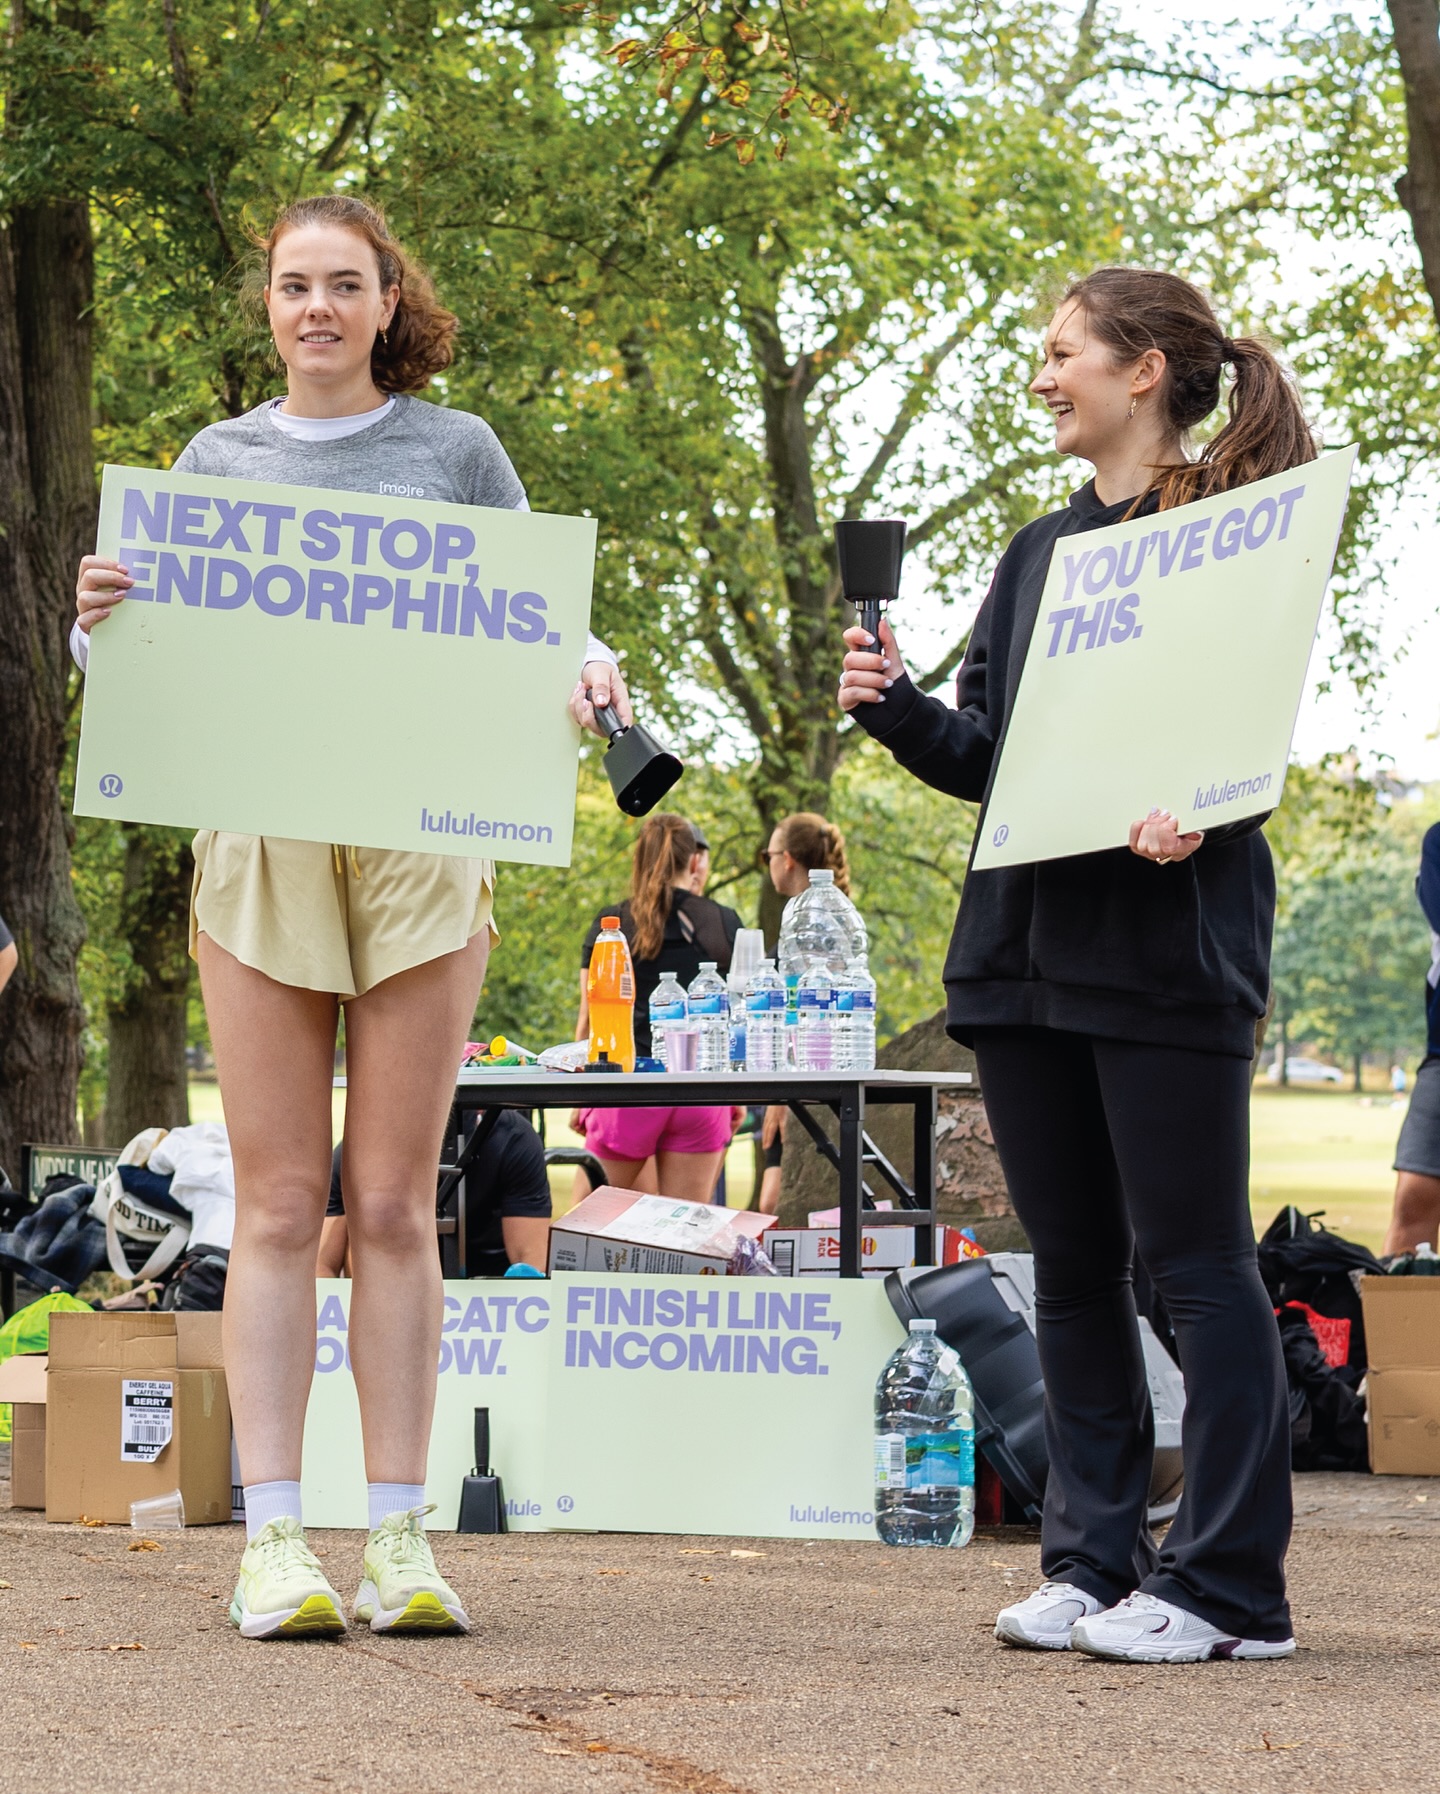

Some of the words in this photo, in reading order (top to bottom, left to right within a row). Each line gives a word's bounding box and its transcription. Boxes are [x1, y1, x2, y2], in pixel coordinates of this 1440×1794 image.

[379, 481, 425, 497] [mo]re
[121, 488, 296, 556] NEXT
[299, 508, 480, 588] STOP,
[1061, 517, 1212, 601] YOU'VE
[1211, 484, 1306, 561] GOT
[118, 548, 561, 646] ENDORPHINS.
[1046, 593, 1144, 658] THIS.
[1193, 772, 1272, 811] lululemon
[420, 808, 553, 844] lululemon
[135, 1211, 175, 1234] TIM
[817, 1237, 826, 1258] PACK
[442, 1296, 550, 1333] CATC
[566, 1287, 719, 1329] FINISH
[728, 1291, 842, 1340] LINE,
[564, 1330, 829, 1375] INCOMING.
[129, 1381, 147, 1389] ENERGY
[133, 1397, 167, 1406] BERRY
[790, 1504, 875, 1525] lululemo
